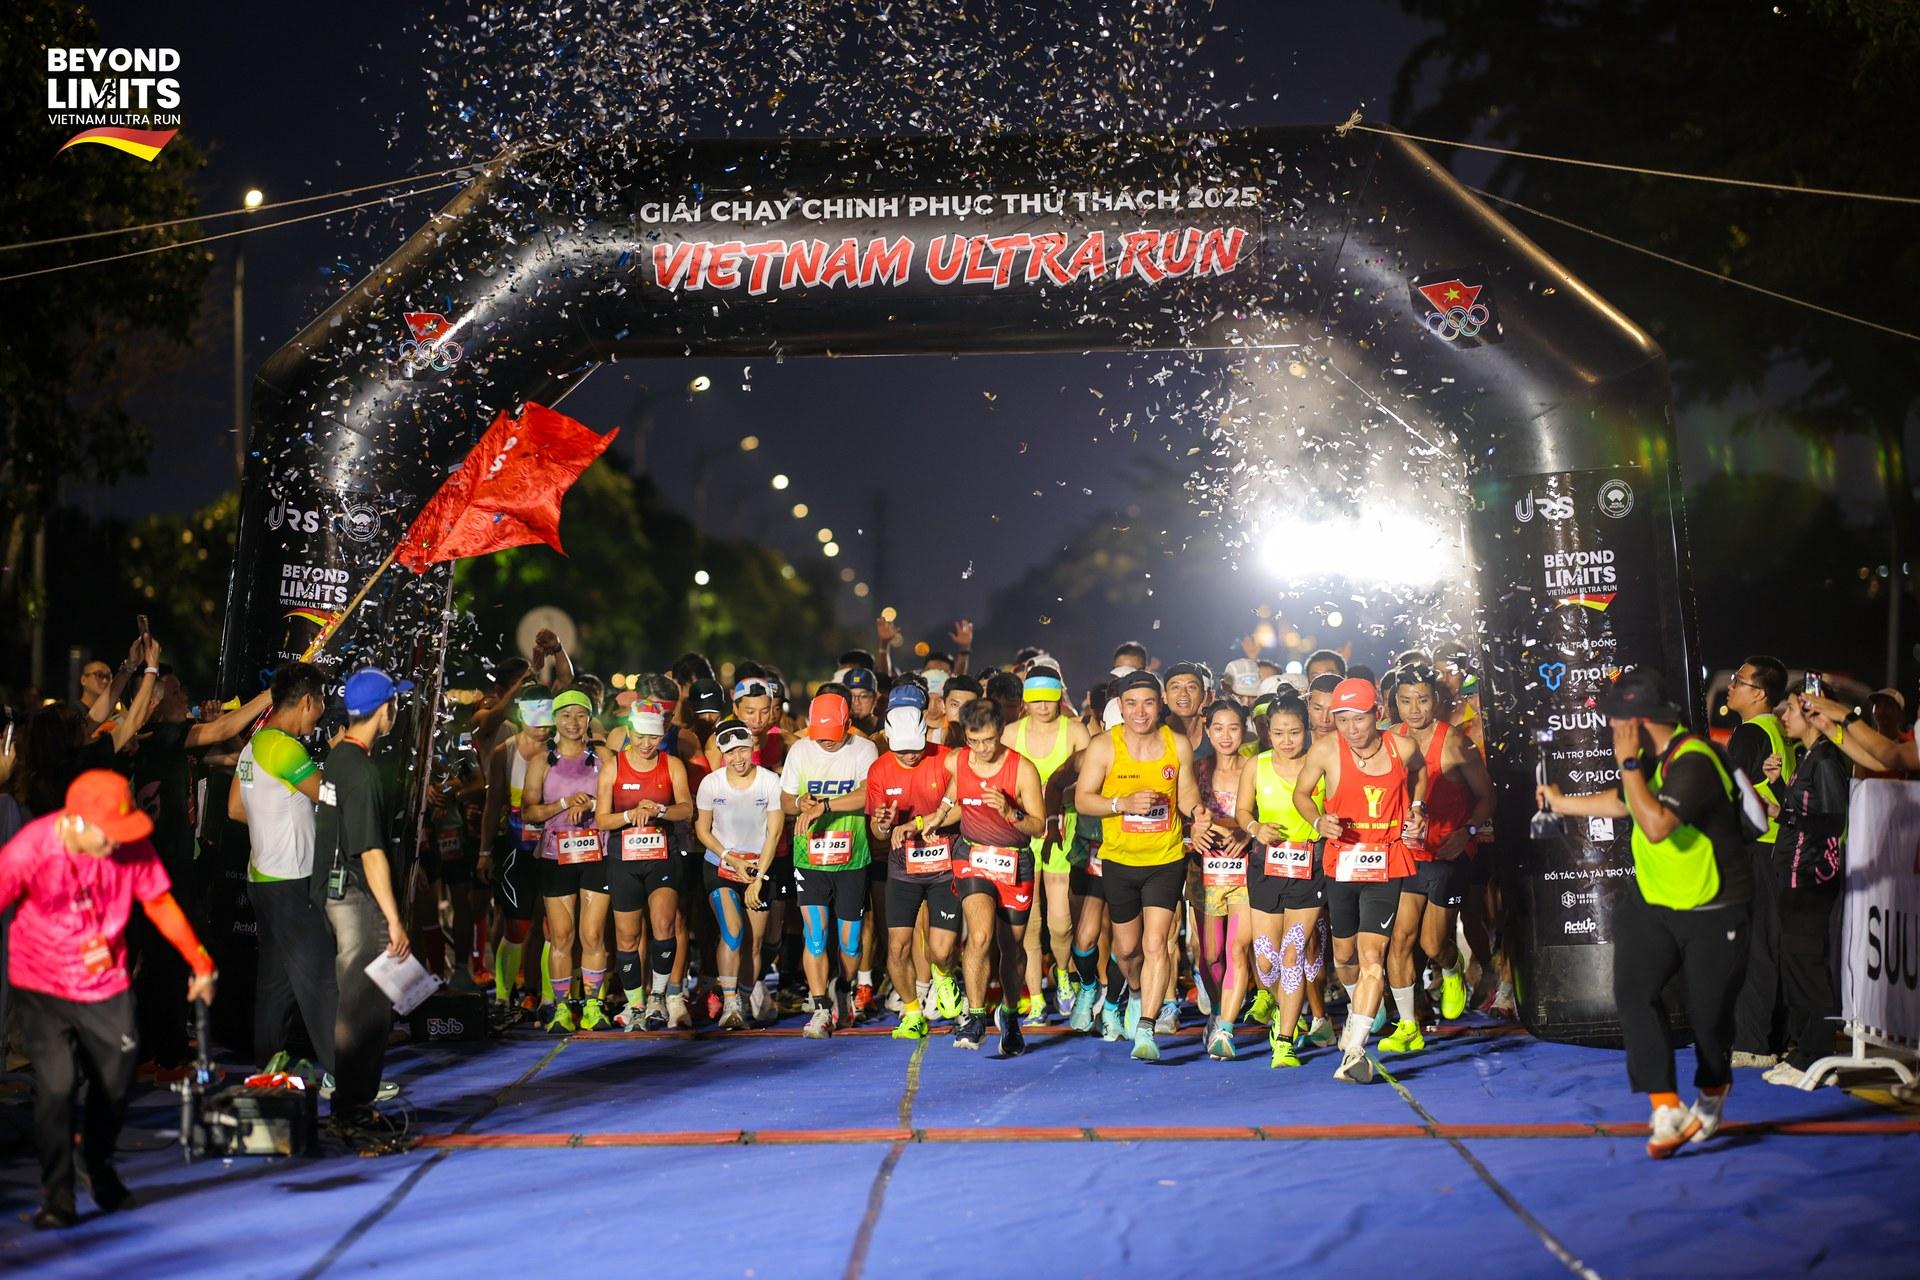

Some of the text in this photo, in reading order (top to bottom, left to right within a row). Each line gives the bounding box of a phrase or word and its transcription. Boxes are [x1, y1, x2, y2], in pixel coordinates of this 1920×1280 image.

[711, 199, 792, 226] CHẠY
[802, 197, 899, 219] CHINH
[909, 194, 994, 221] PHỤC
[1187, 187, 1257, 209] 2025
[653, 226, 1247, 296] VIETNAM ULTRA RUN
[1544, 550, 1615, 568] BEYOND
[282, 564, 349, 584] BEYOND
[1545, 566, 1616, 587] LIMITS
[280, 580, 348, 603] LIMITS
[1547, 588, 1577, 596] VIETNAM
[291, 653, 301, 661] TR
[1552, 750, 1565, 760] TÀI
[807, 780, 854, 795] BCR
[563, 839, 595, 849] 60008
[628, 836, 660, 845] 60011
[912, 848, 944, 858] 61007
[1208, 860, 1242, 870] 60028
